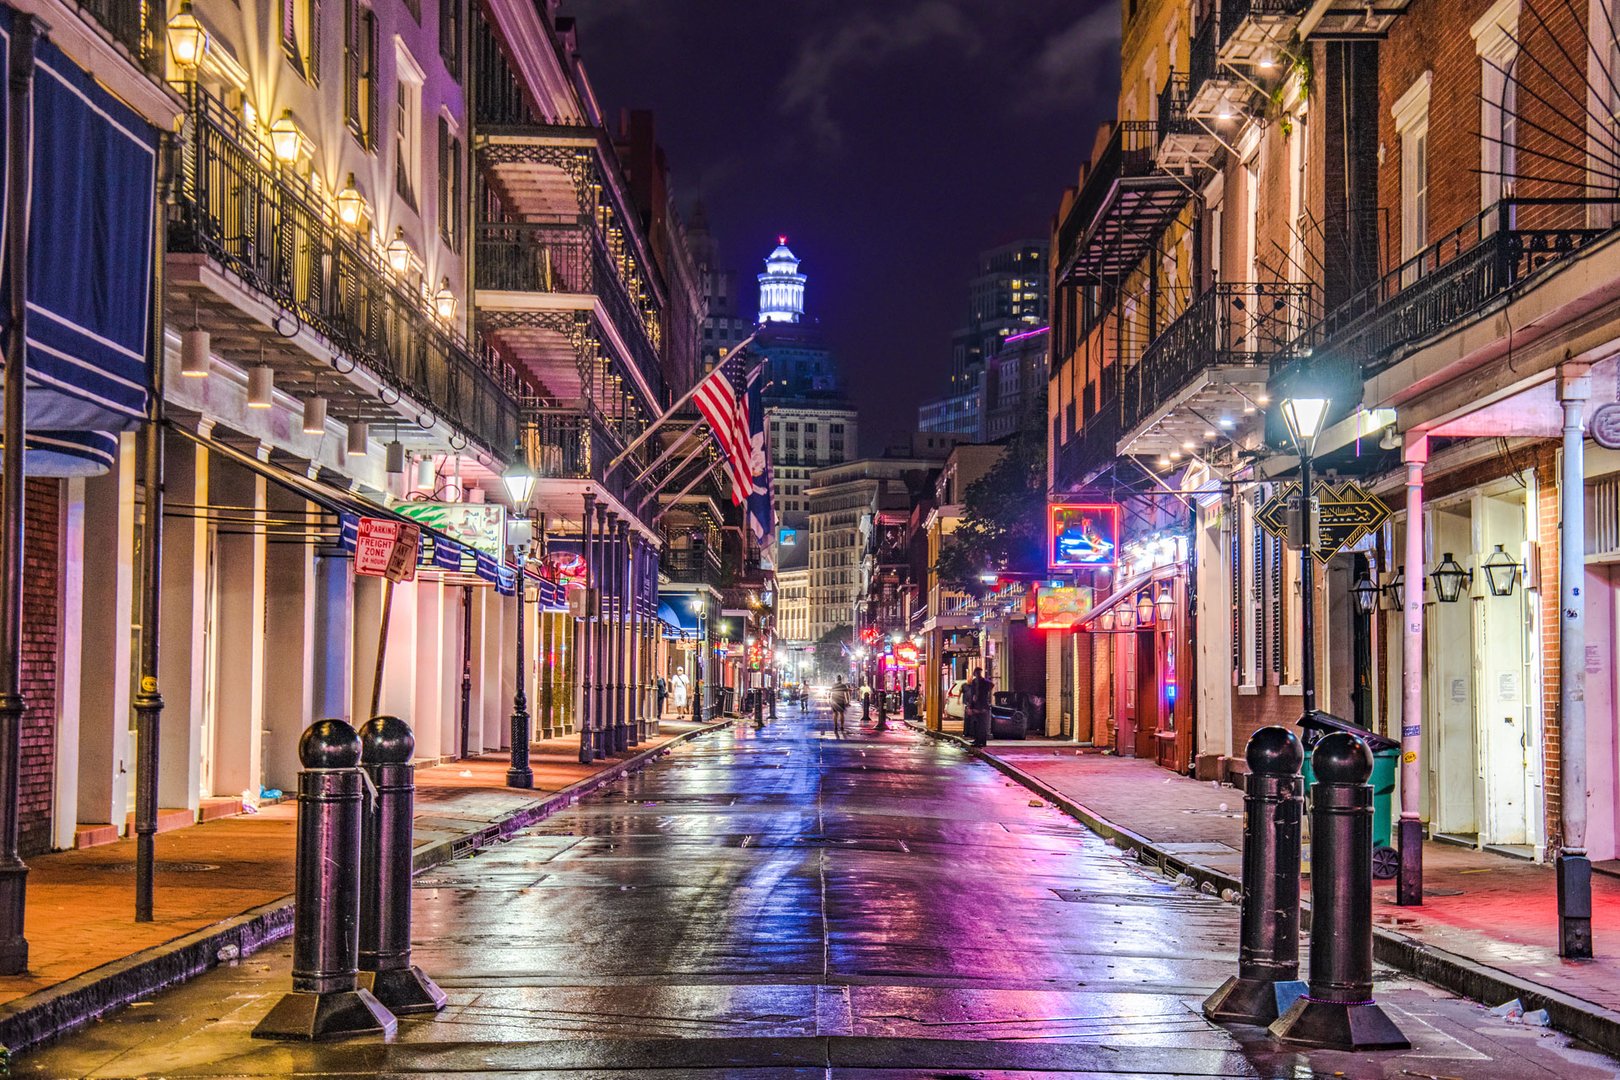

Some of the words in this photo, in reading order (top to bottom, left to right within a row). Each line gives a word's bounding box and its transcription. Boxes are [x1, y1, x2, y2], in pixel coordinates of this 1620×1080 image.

[359, 522, 371, 534] NO
[371, 525, 394, 535] PARKING
[361, 538, 392, 549] FREIGHT
[365, 548, 385, 557] ZONE
